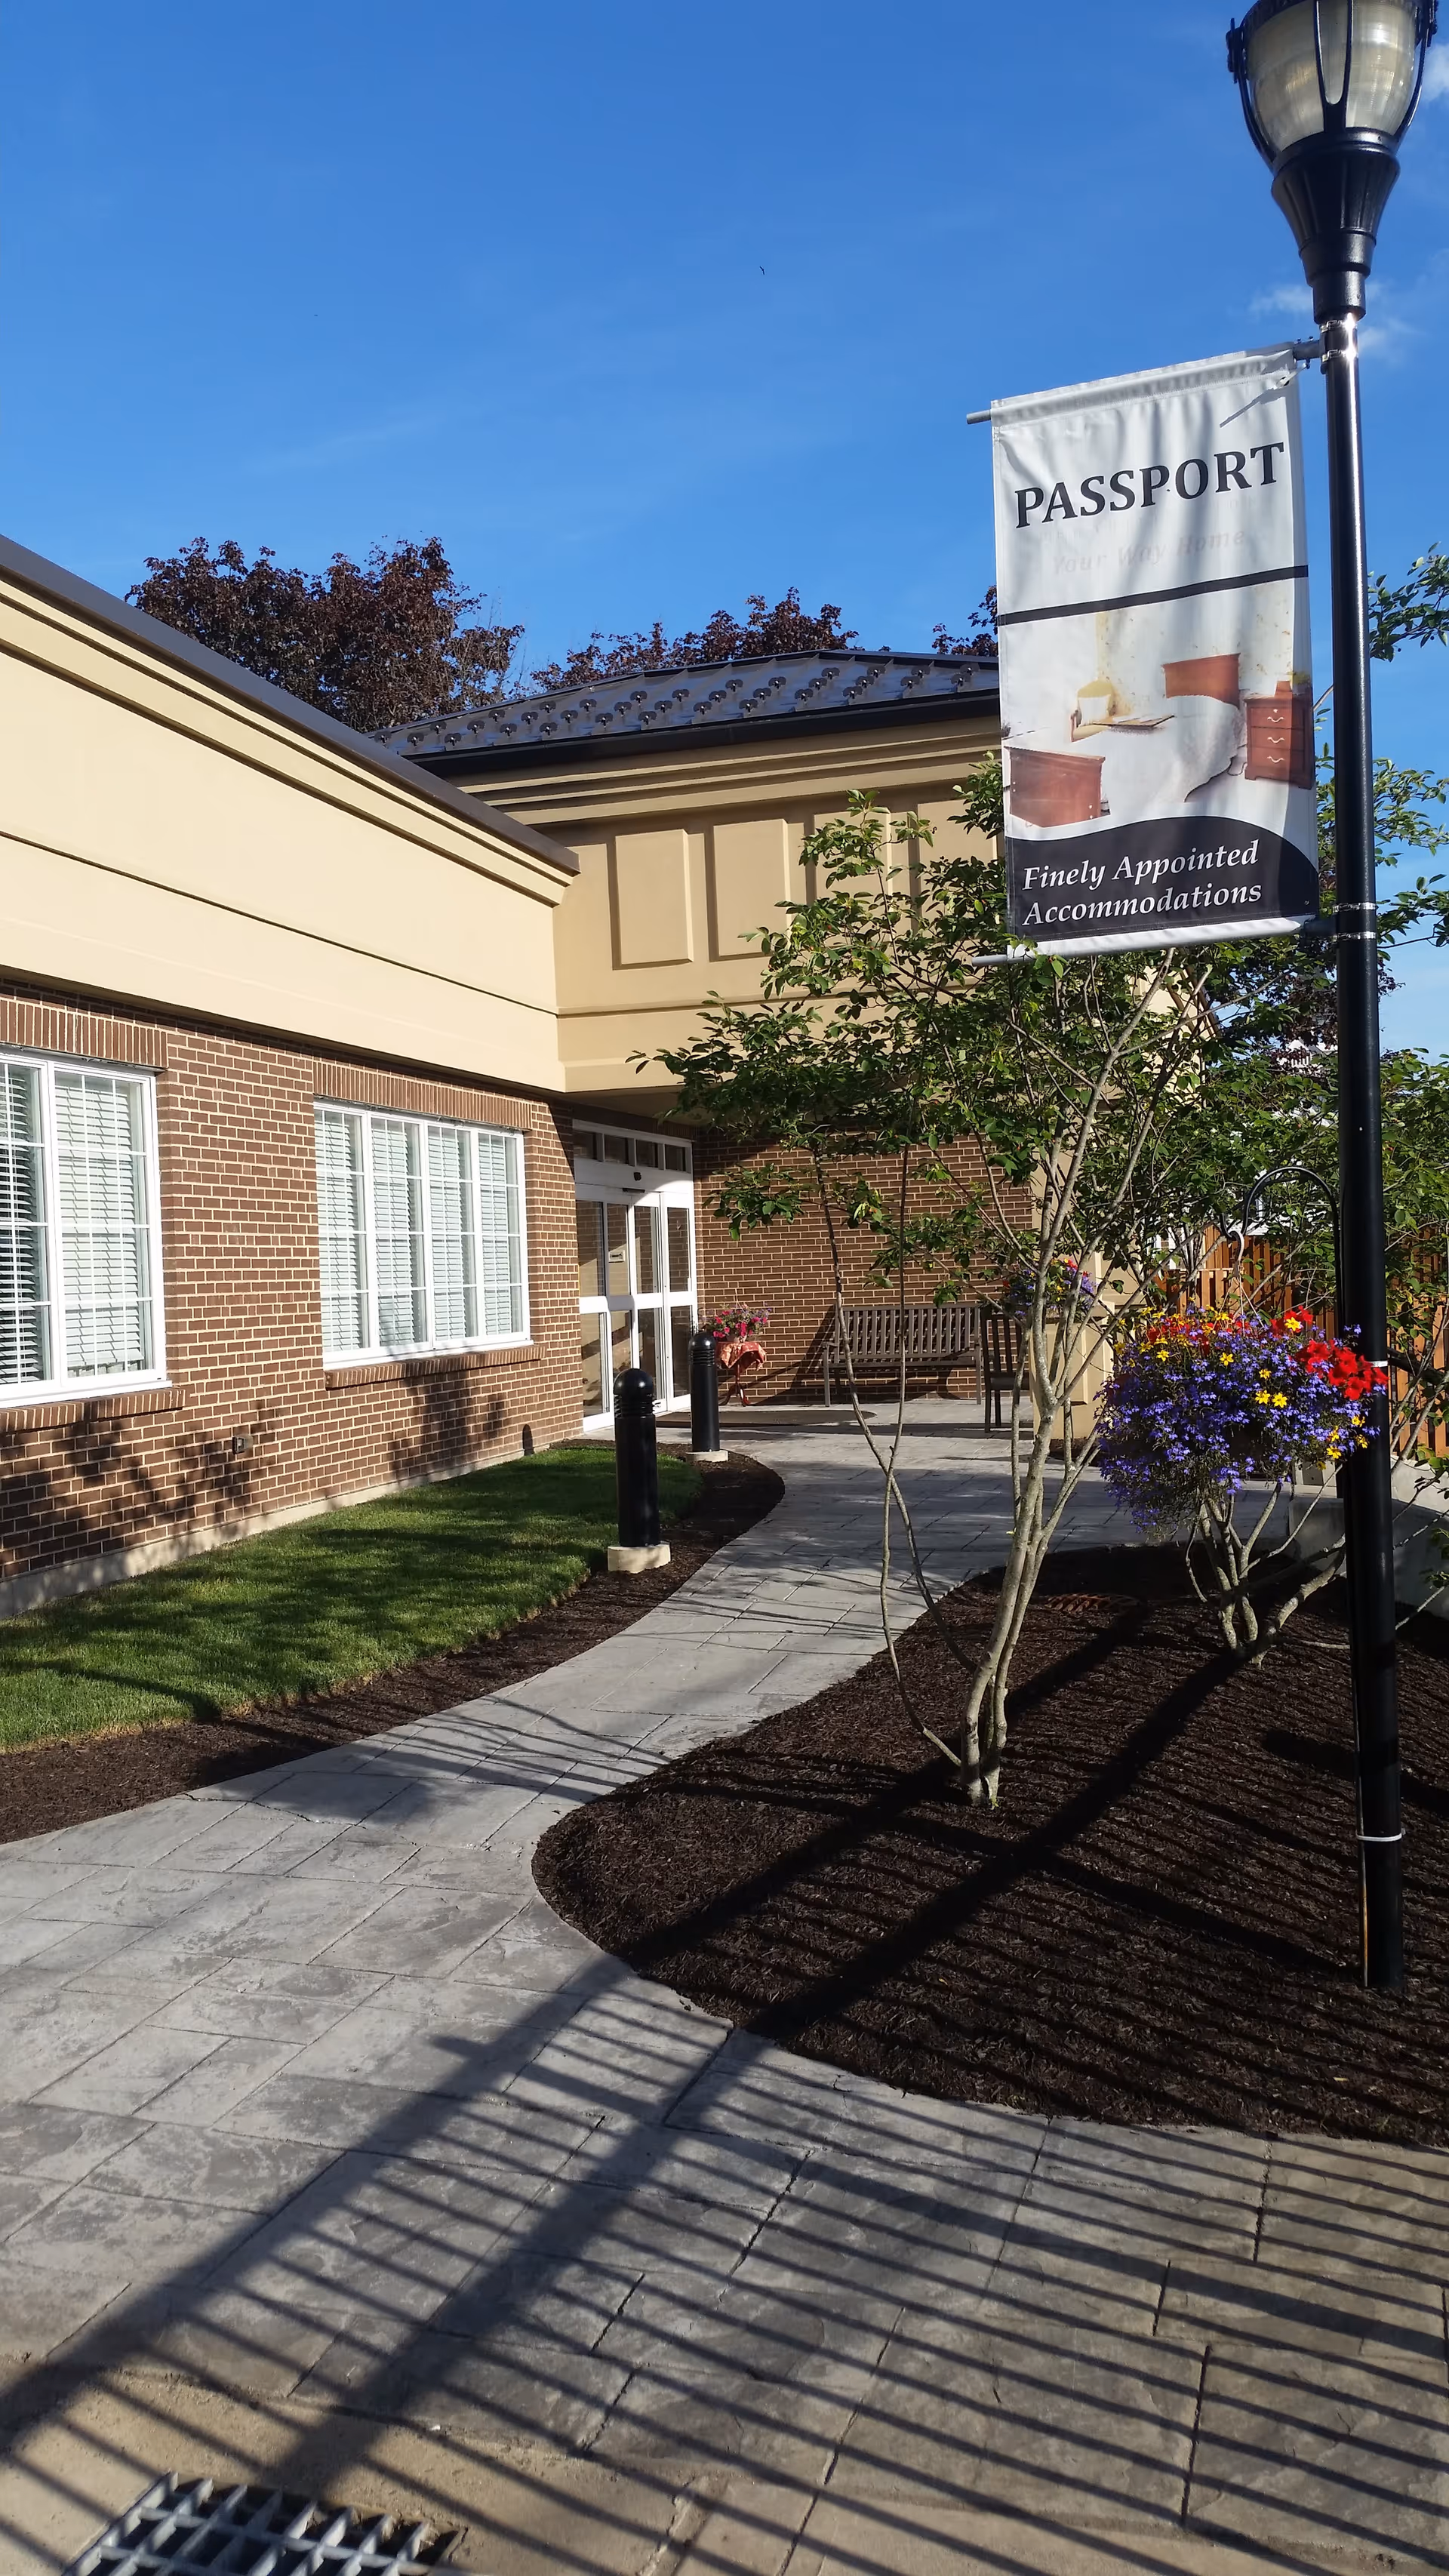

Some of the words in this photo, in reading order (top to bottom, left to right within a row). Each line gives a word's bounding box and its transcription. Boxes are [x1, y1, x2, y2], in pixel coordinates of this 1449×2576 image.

[1014, 442, 1284, 529] PASSPORT
[1022, 860, 1106, 890] Finely
[1111, 839, 1259, 884] Appointed
[1022, 884, 1262, 925] Accommodations
